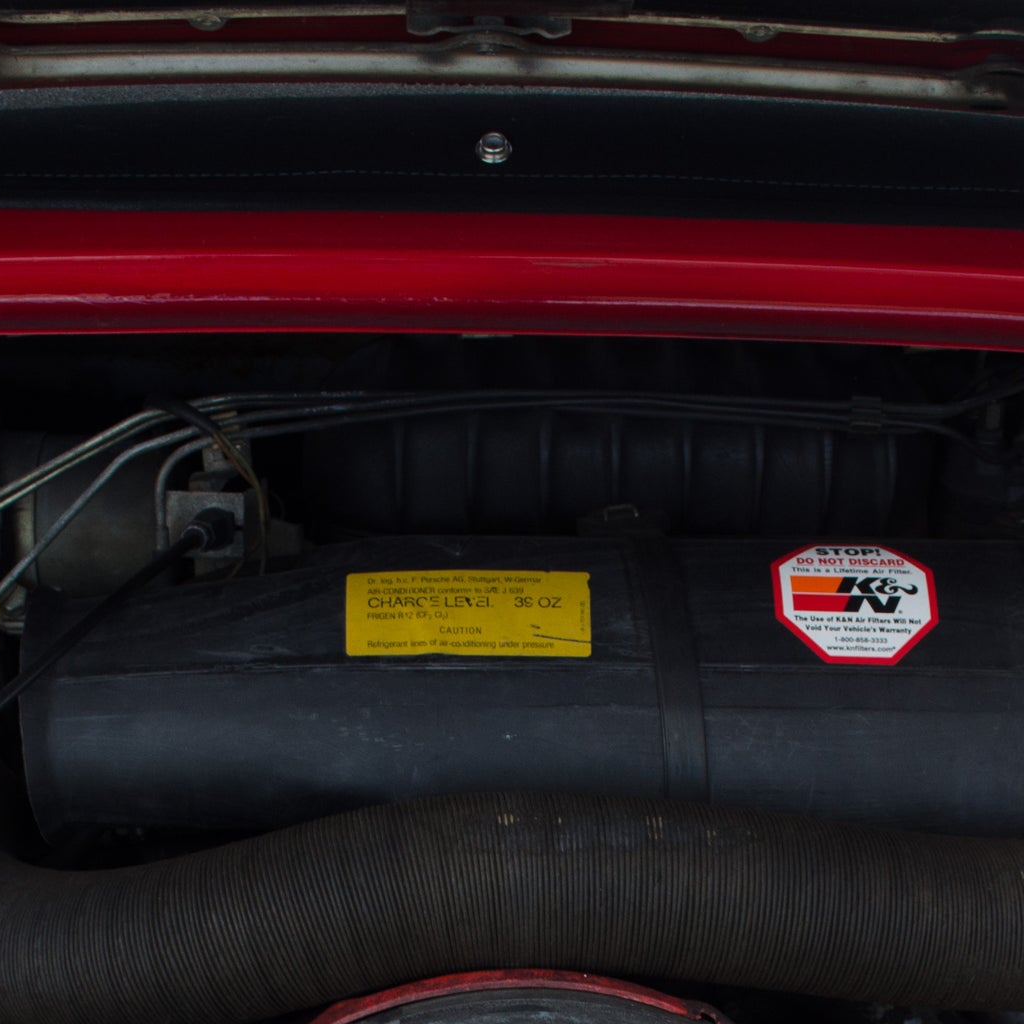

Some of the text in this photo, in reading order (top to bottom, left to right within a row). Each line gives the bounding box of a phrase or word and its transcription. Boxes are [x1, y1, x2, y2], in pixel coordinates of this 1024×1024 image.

[815, 547, 881, 557] STOP!
[796, 557, 905, 566] DO NOT DISCARD
[538, 597, 563, 608] OZ
[867, 617, 891, 625] Filters
[439, 626, 482, 634] CAUTION
[843, 625, 877, 633] Vehicle's
[879, 626, 912, 635] Warranty
[367, 641, 409, 649] Refrigerant
[429, 639, 438, 647] of
[499, 640, 520, 649] under
[834, 636, 887, 644] 1-800-858-3333
